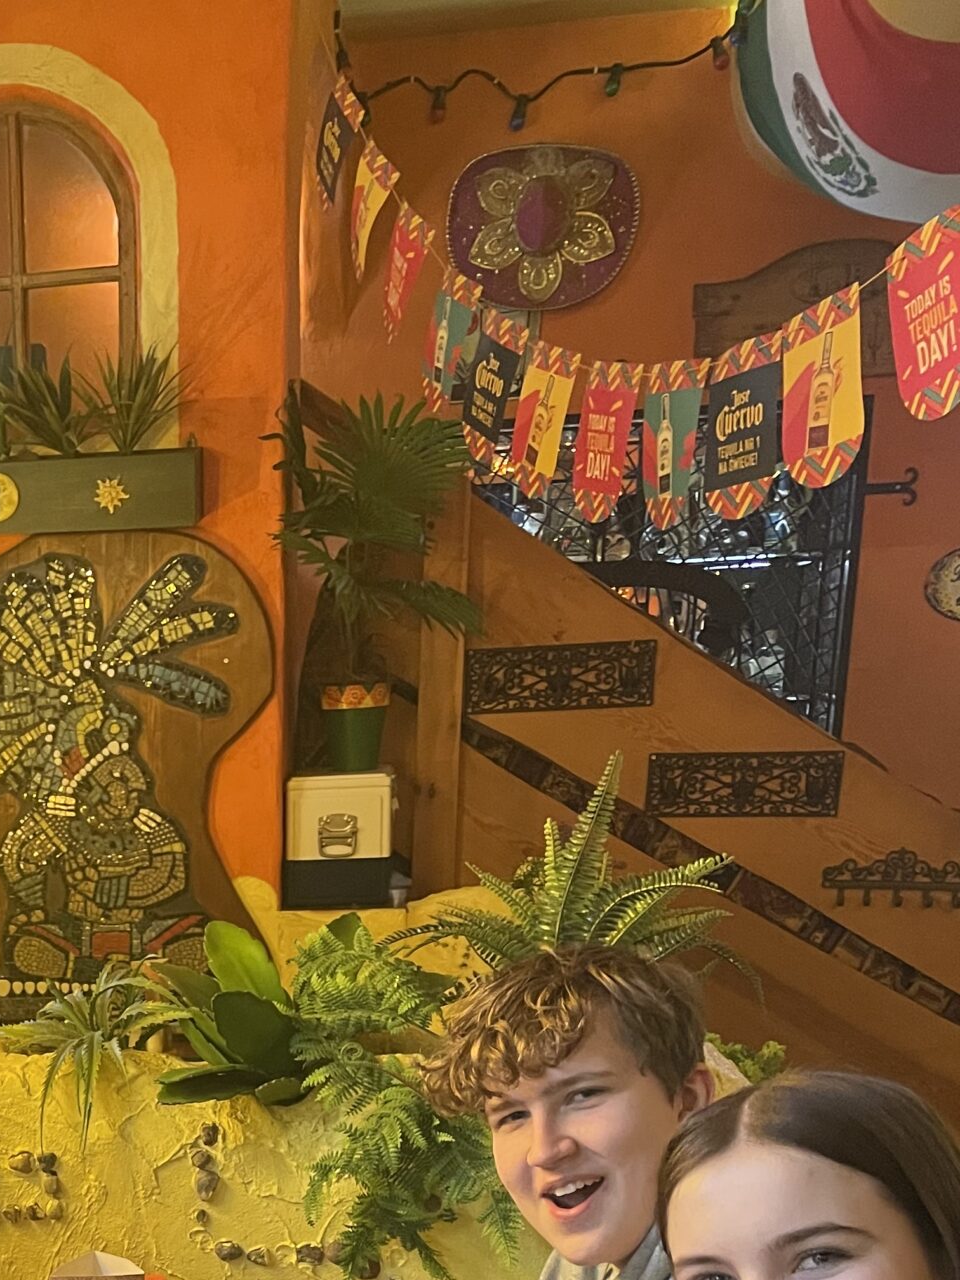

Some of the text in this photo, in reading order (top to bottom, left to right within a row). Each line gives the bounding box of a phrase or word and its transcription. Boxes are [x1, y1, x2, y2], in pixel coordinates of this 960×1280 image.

[904, 275, 952, 322] TODAY IS
[908, 295, 959, 344] TEQUILA
[916, 320, 958, 375] DAY!
[715, 402, 764, 442] Cuervo
[585, 451, 611, 481] DAY!
